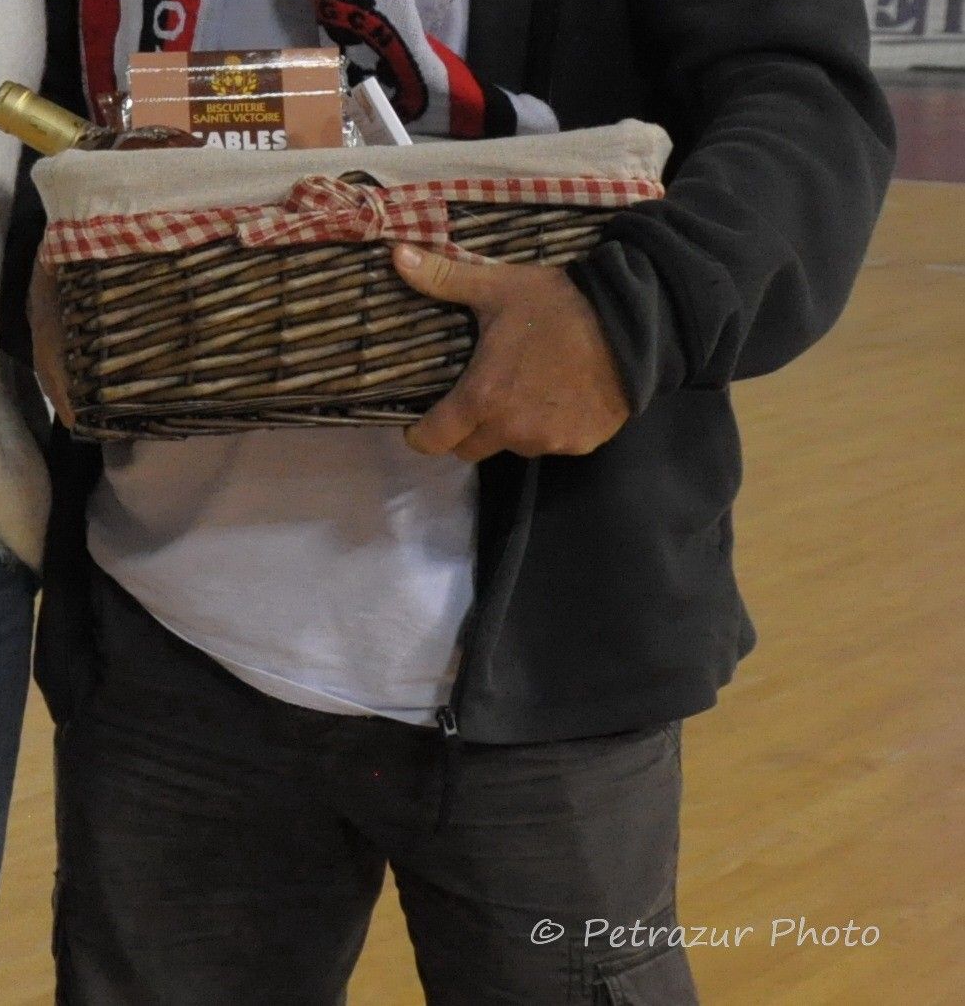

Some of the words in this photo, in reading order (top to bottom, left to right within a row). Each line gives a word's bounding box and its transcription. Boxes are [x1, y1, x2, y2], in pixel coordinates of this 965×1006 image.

[206, 102, 266, 113] BISCUITERIE
[192, 114, 230, 124] SAINTE
[233, 112, 282, 123] VICTOIRE
